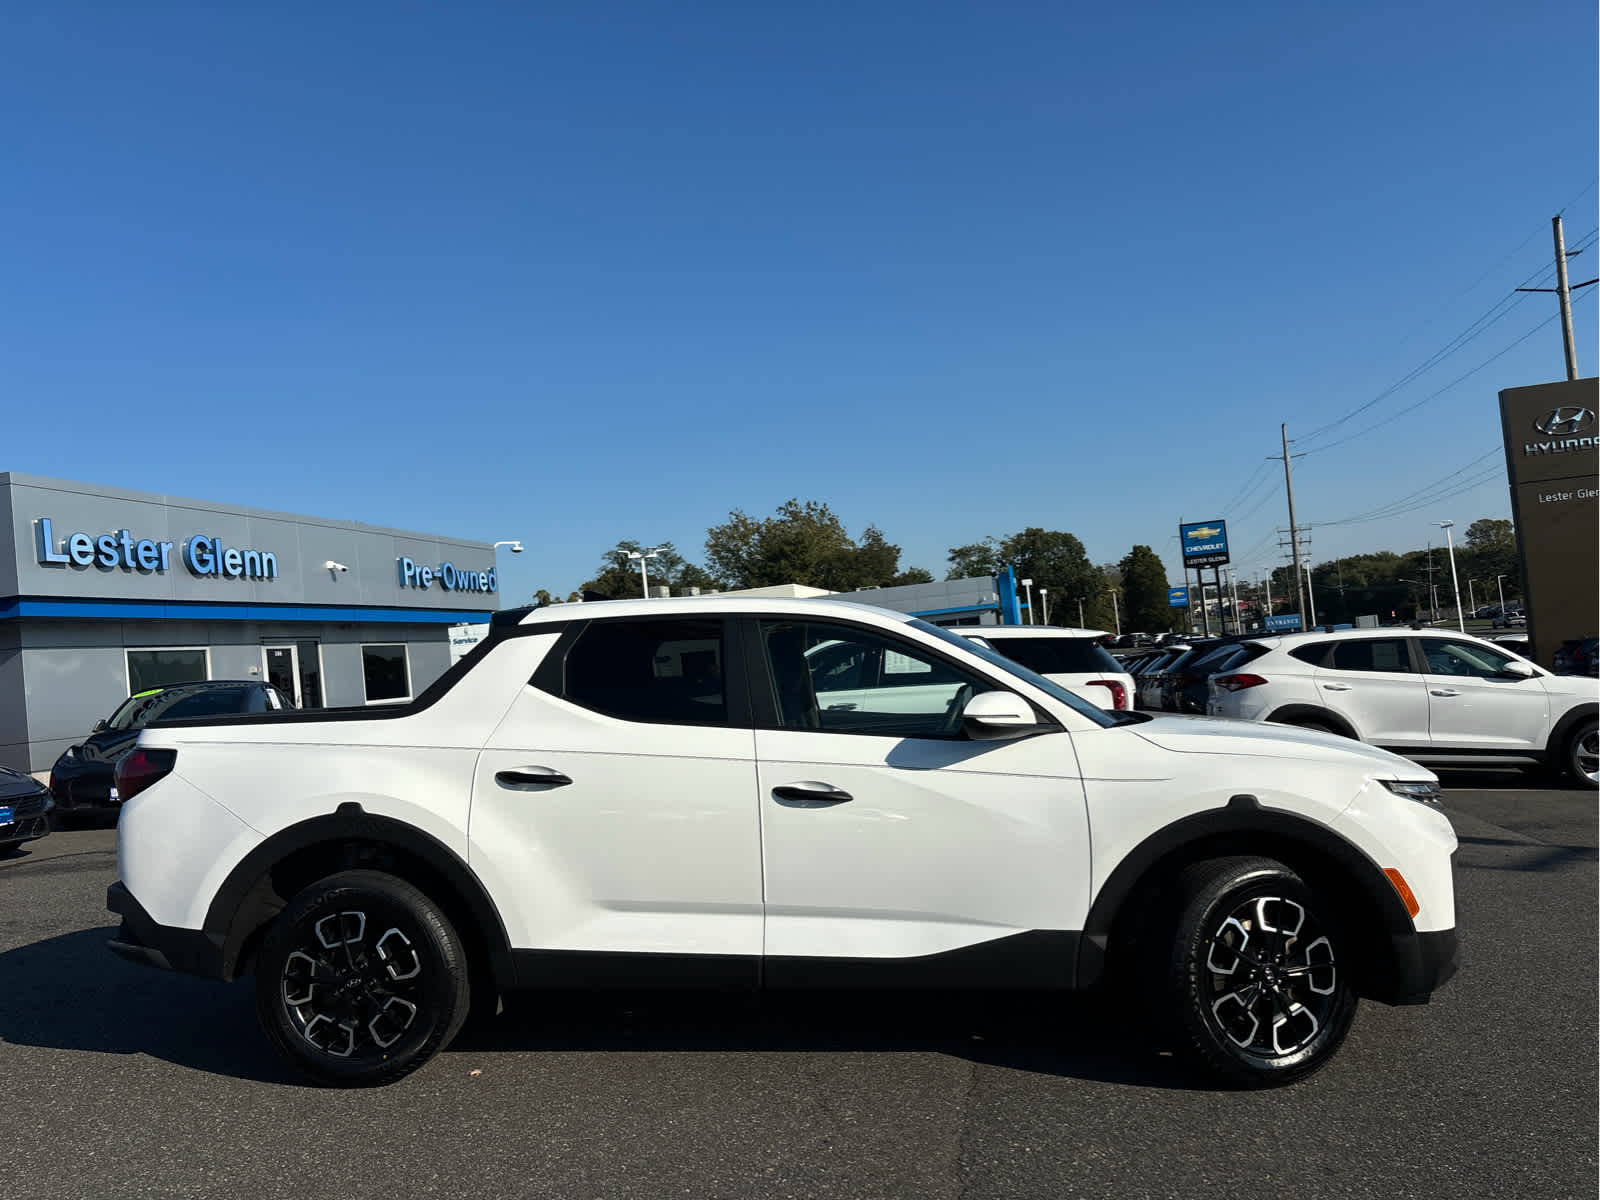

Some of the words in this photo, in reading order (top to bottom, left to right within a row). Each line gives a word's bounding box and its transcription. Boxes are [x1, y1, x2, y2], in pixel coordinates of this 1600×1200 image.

[1538, 492, 1573, 503] Lester
[38, 518, 173, 571] Lester
[184, 535, 278, 578] Glenn
[1186, 543, 1225, 553] CHEVROLET
[399, 557, 497, 592] Pre-Owned
[1267, 618, 1299, 626] ENTRANCE
[453, 637, 478, 645] Service
